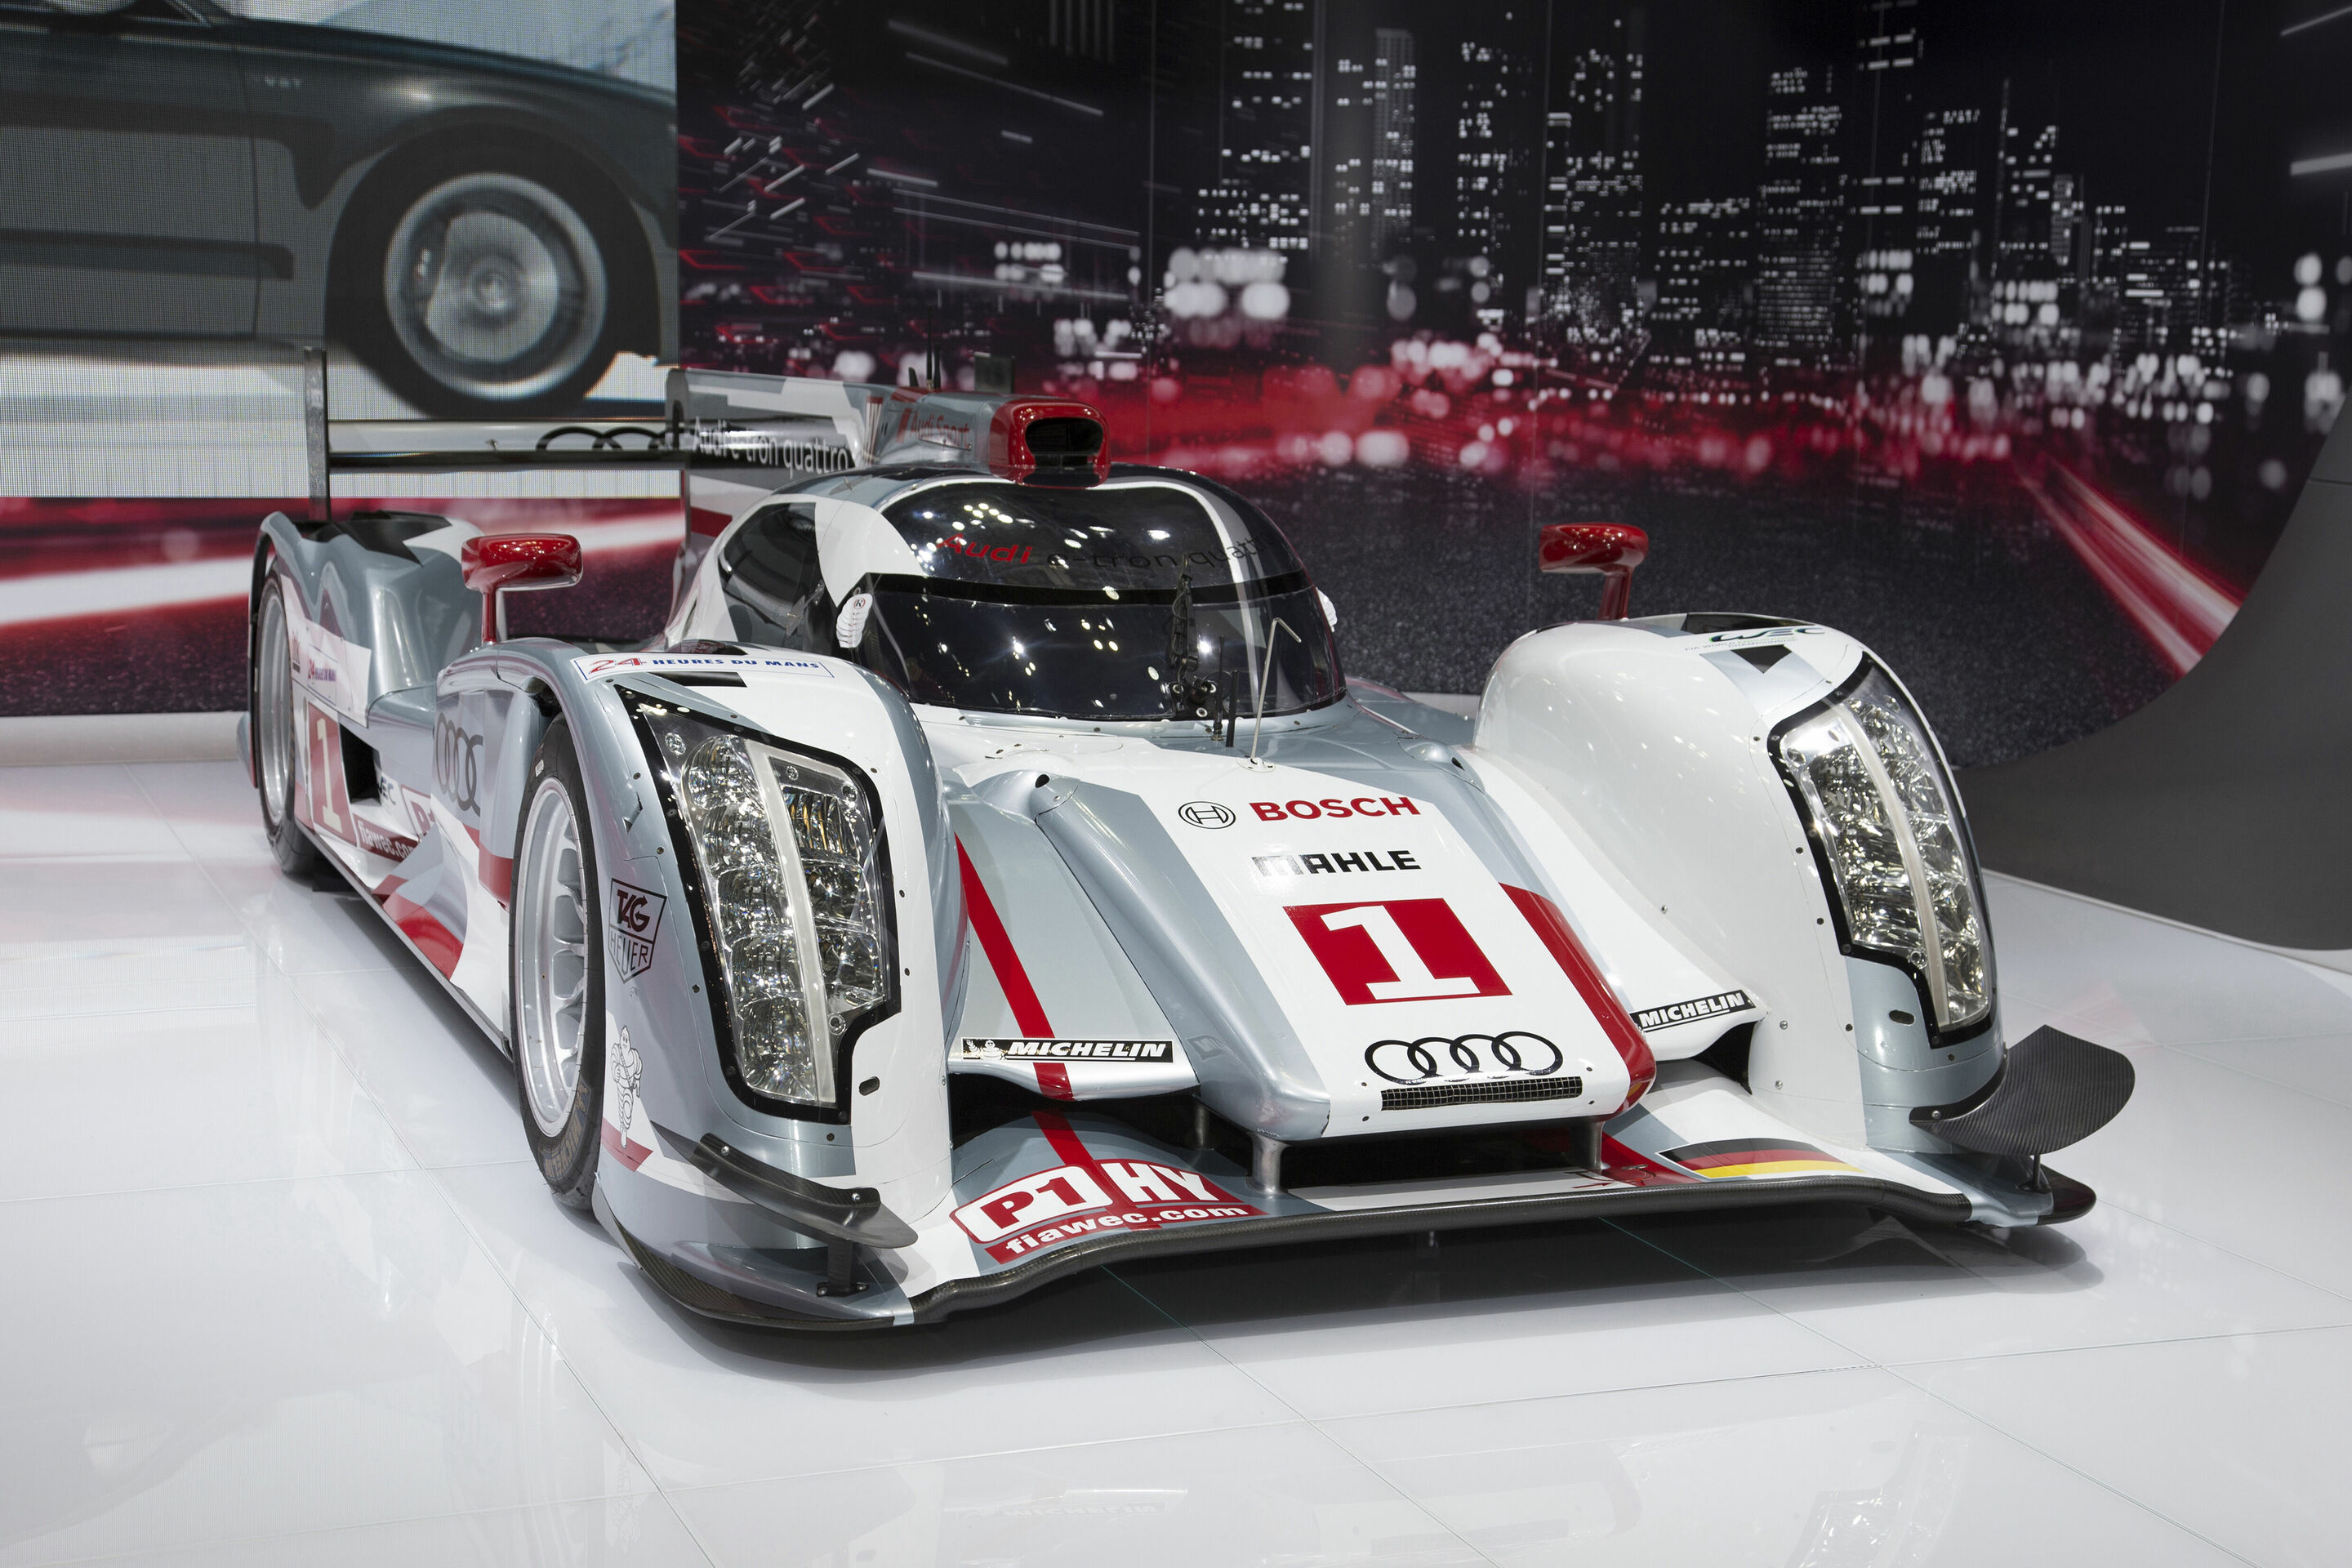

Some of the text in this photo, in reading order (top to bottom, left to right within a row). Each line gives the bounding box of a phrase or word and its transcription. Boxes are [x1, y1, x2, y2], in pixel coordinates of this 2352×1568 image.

[693, 416, 728, 457] Audi
[782, 437, 849, 479] quattro
[909, 410, 970, 451] Audi Sport
[936, 532, 1033, 564] Audi
[1046, 552, 1178, 569] e-tron
[588, 657, 648, 675] 24
[653, 658, 724, 666] HEURES
[764, 660, 819, 669] MANS
[316, 717, 343, 834] 1
[1249, 796, 1422, 822] BOSCH
[1251, 849, 1423, 876] MAHLE
[617, 889, 651, 933] TAG
[610, 931, 649, 976] HEUER
[1320, 905, 1481, 1000] 1
[1637, 992, 1746, 1028] MICHELIN
[1008, 1041, 1167, 1058] MICHELIN
[979, 1162, 1220, 1230] P1 HY
[1005, 1206, 1250, 1254] fiawec.com
